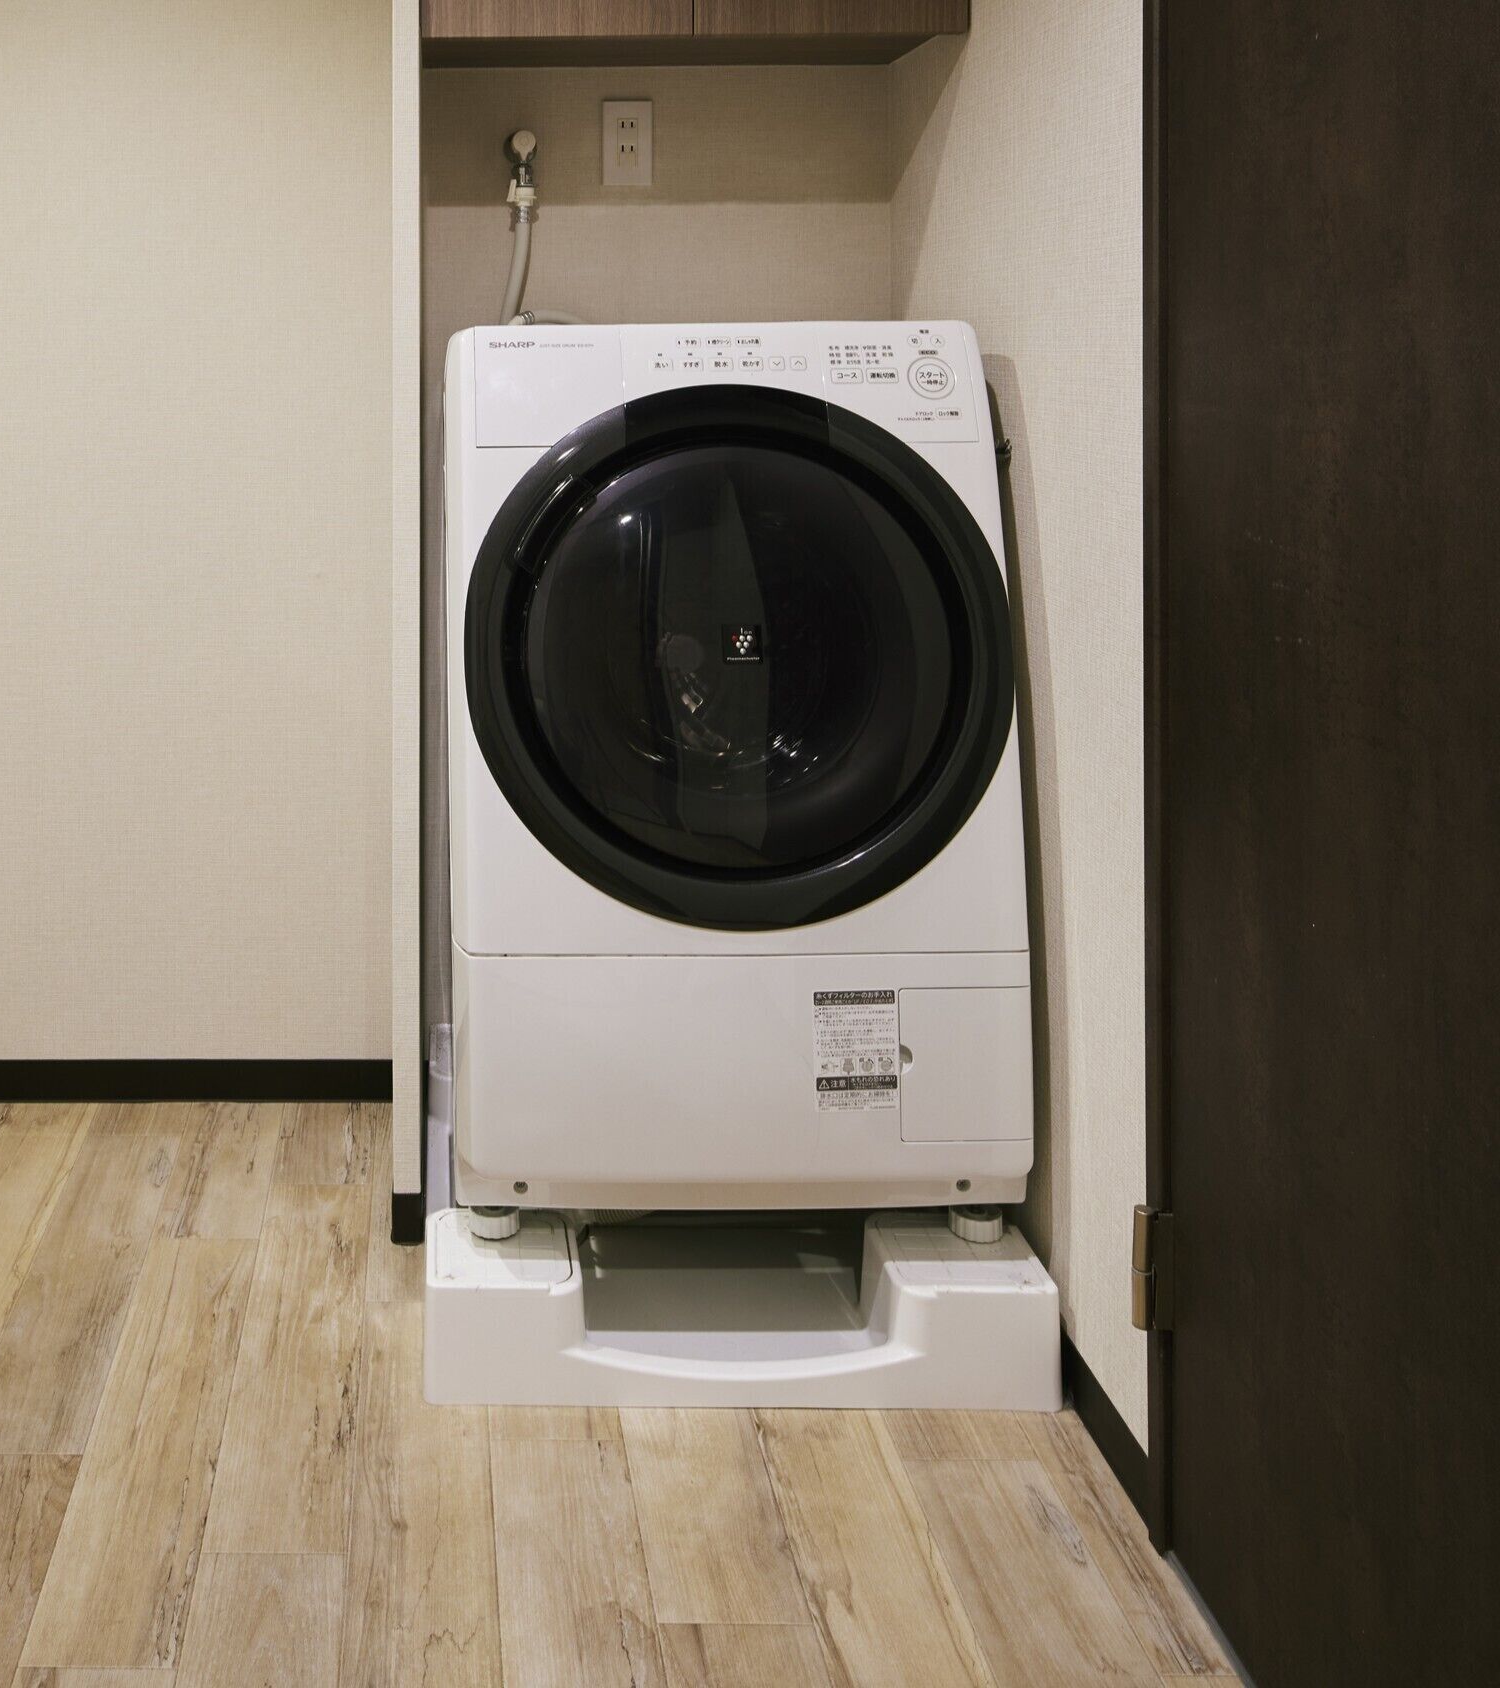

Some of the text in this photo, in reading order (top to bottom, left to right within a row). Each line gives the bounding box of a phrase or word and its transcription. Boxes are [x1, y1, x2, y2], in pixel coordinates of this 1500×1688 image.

[816, 991, 892, 999] 糸くずフィルターのお手入れ
